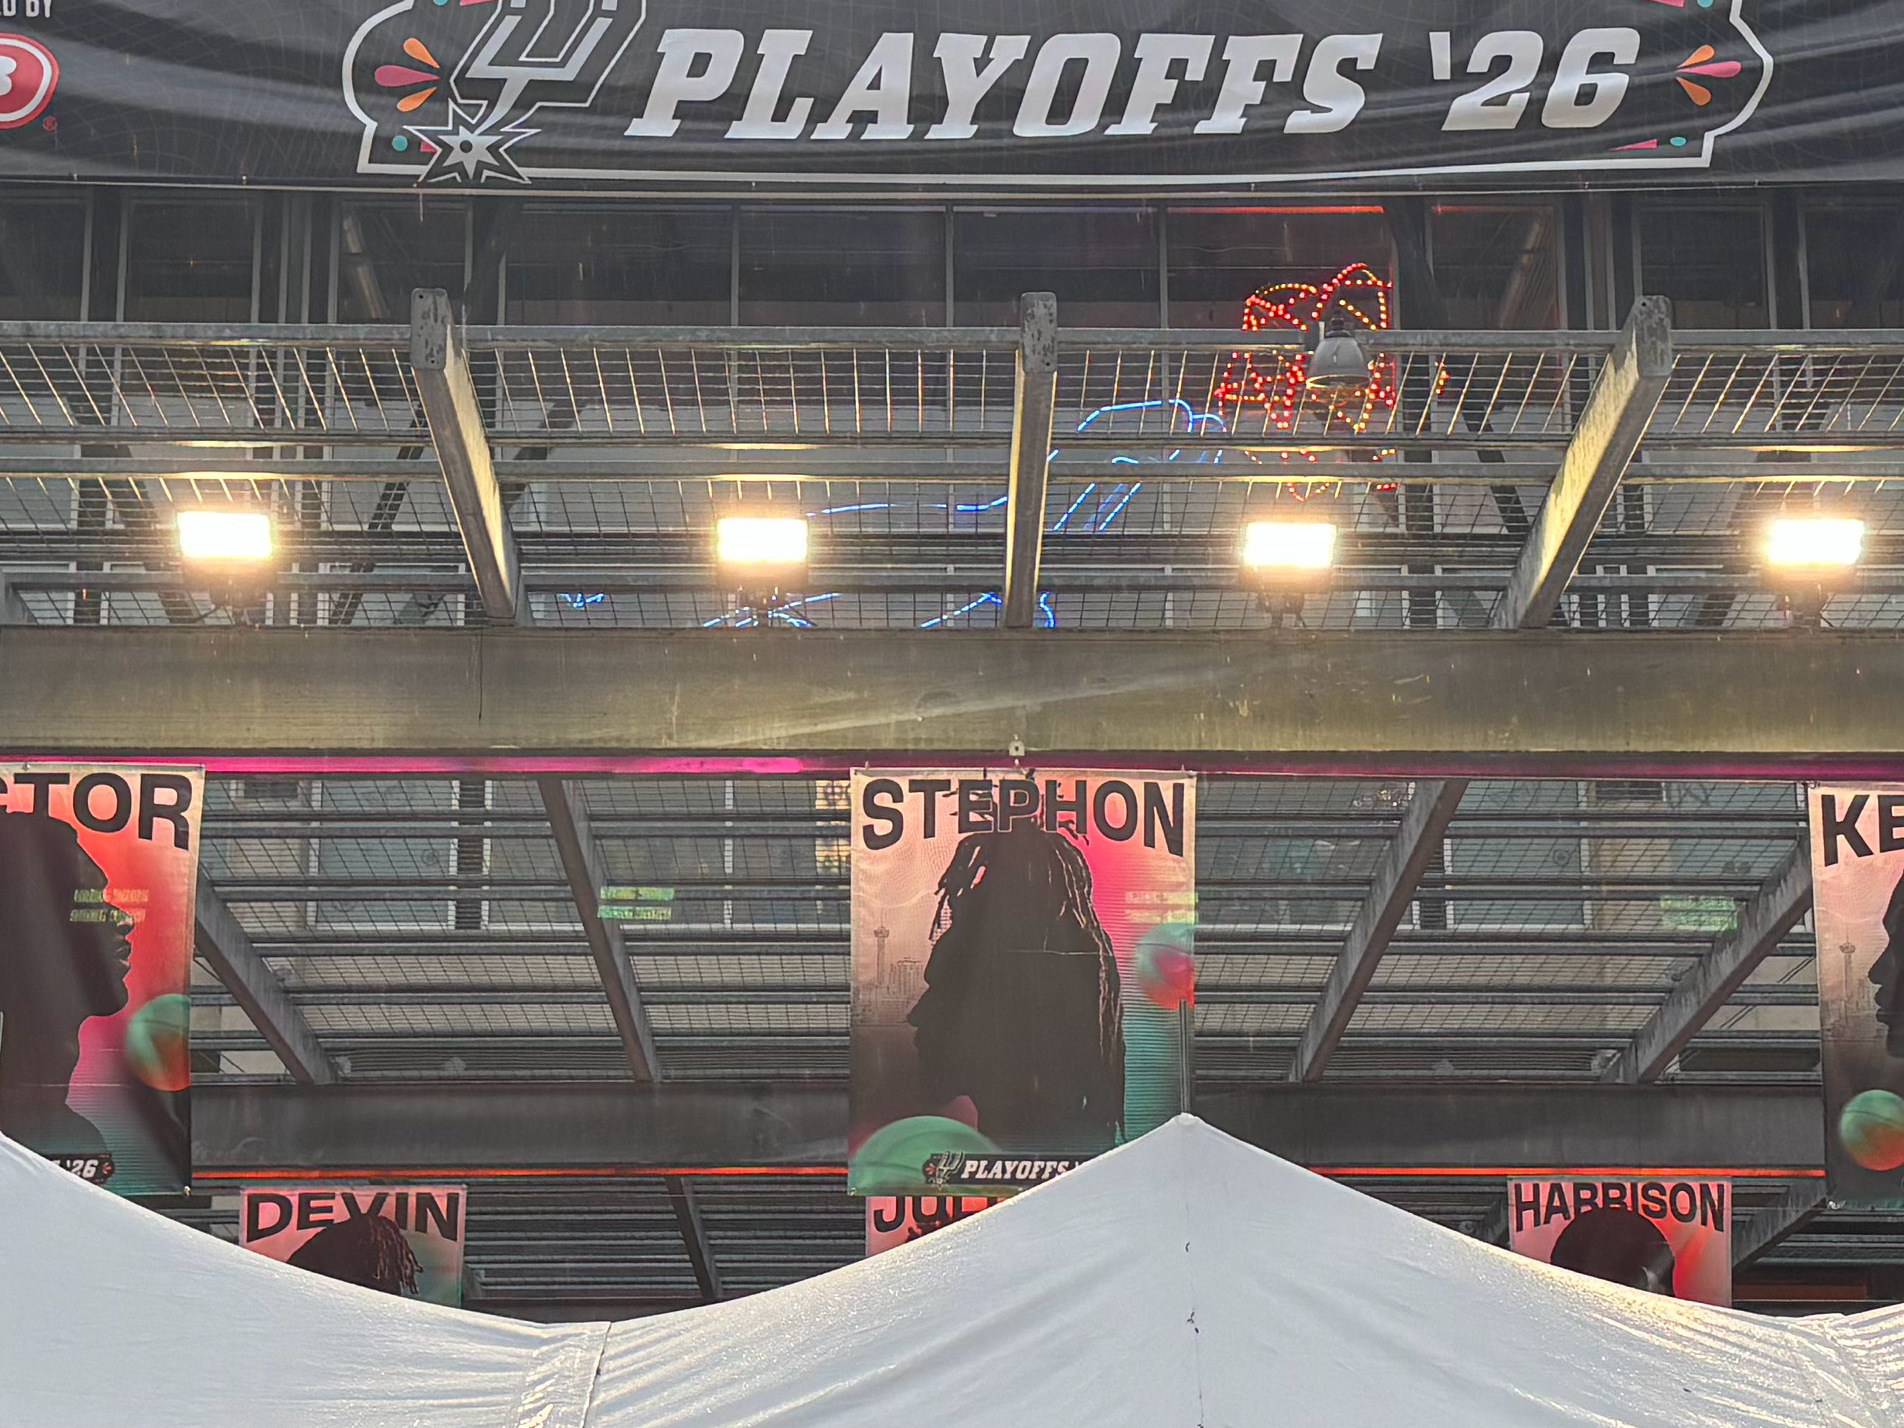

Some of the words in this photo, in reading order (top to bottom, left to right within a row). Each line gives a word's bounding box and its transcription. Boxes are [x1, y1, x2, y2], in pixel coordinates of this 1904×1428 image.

[623, 27, 1384, 140] PLAYOFFS
[1431, 27, 1642, 133] '26
[862, 778, 1186, 858] STEPHON
[247, 1192, 460, 1244] DEVIN
